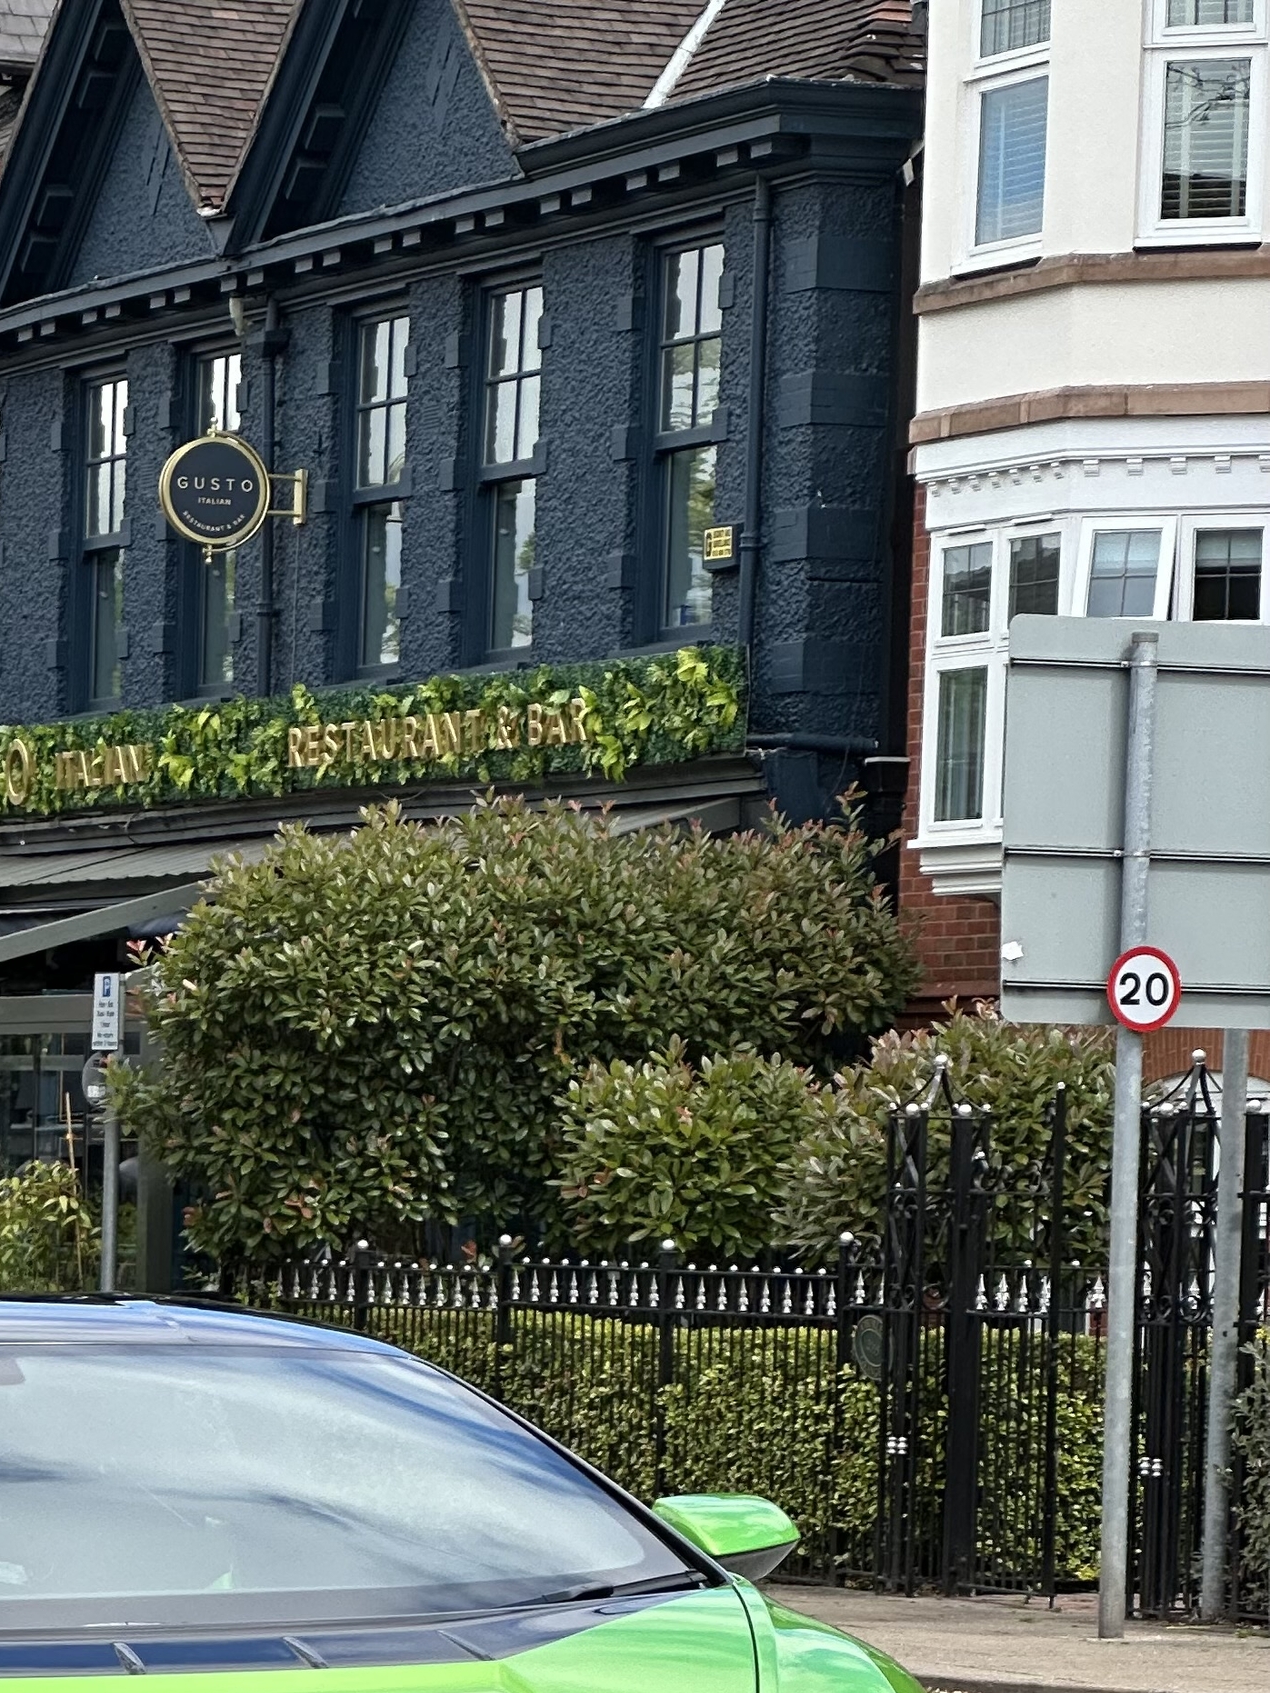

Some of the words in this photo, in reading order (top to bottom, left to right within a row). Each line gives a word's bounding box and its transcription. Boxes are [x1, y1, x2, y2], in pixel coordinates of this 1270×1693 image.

[177, 476, 253, 492] GUSTO
[197, 497, 231, 505] ITALIAN
[287, 708, 483, 767] RESTAURANT
[496, 705, 517, 750] &
[527, 697, 588, 746] BAR
[1119, 972, 1169, 1006] 20
